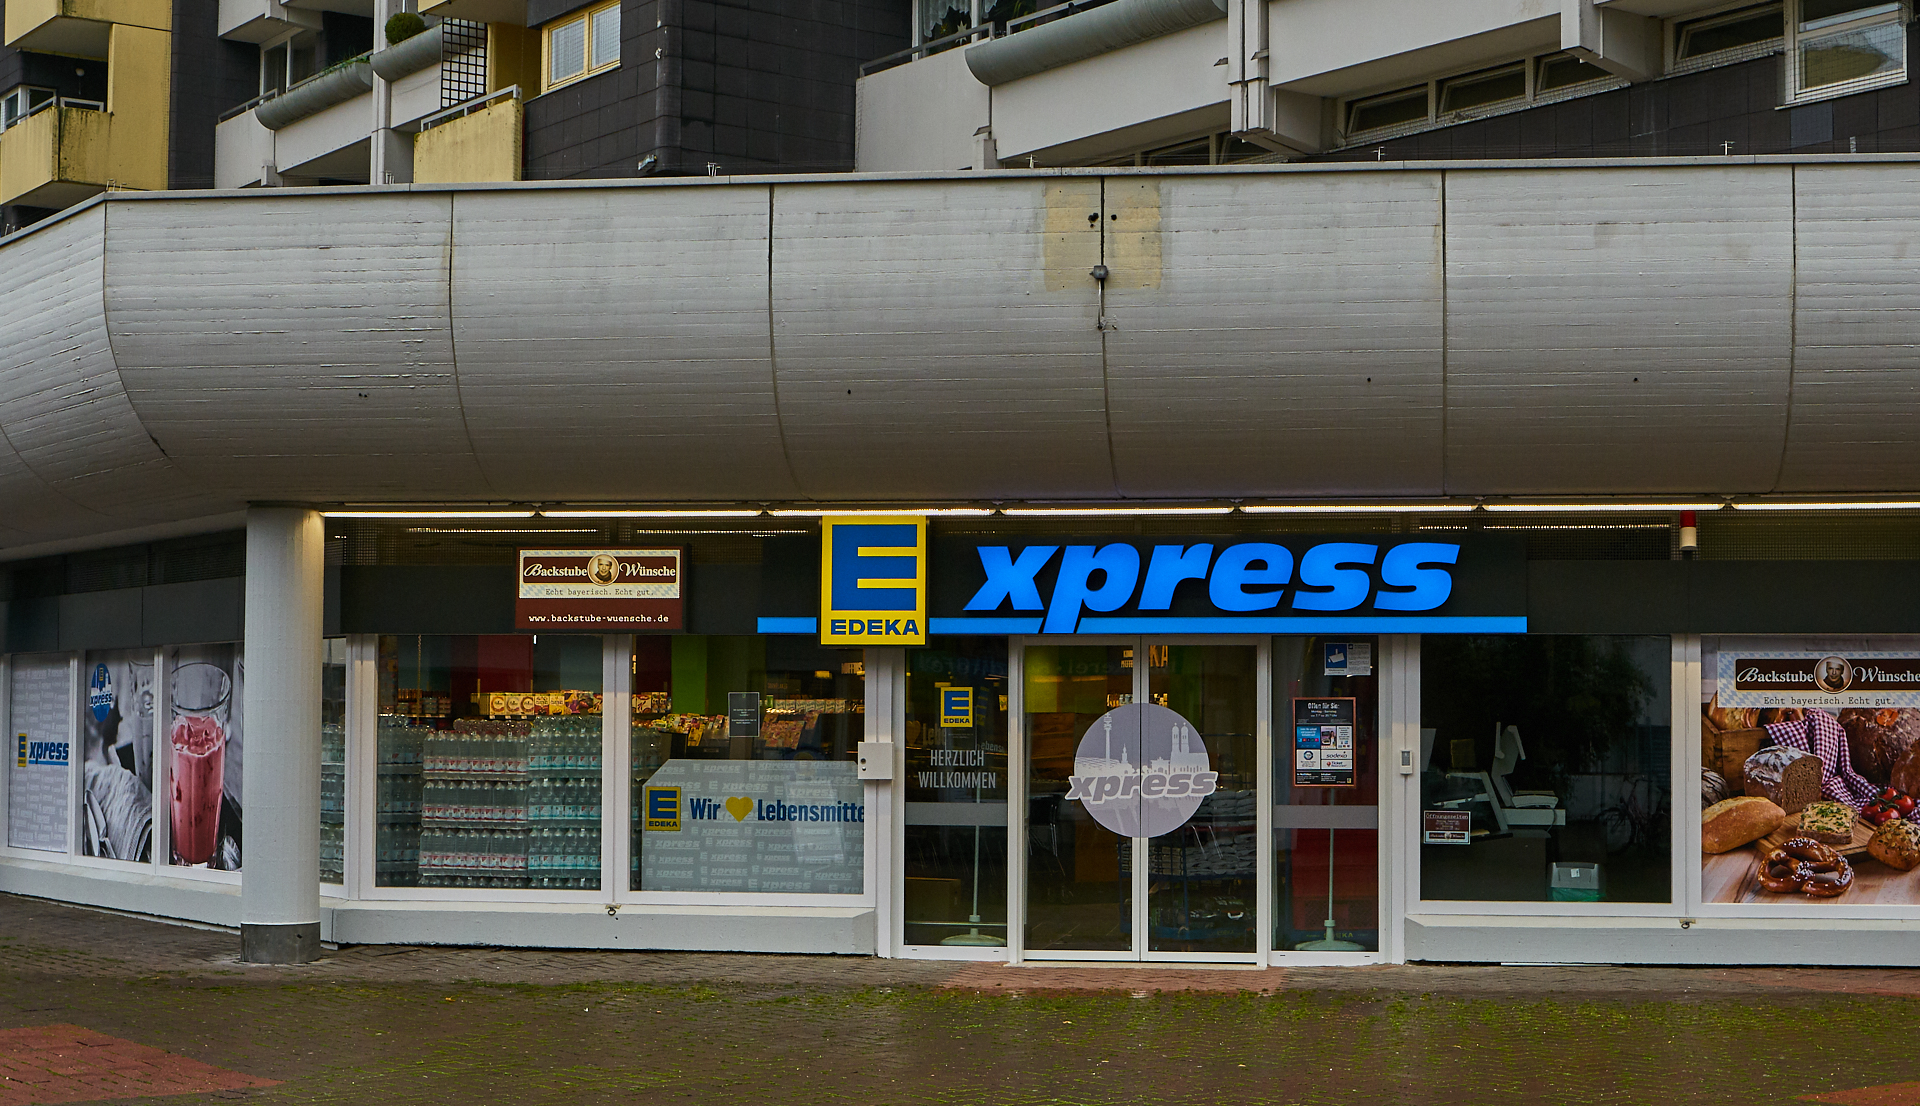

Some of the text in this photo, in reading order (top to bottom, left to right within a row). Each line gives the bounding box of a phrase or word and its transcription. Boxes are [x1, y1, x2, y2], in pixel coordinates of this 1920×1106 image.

[524, 562, 676, 577] Backstube Wünsche
[831, 524, 1460, 634] E xpress
[545, 588, 655, 597] Echt bayerisch. Echt gut.
[528, 614, 669, 623] www.backstube-wuensche.de
[831, 619, 919, 635] EDEKA
[1737, 665, 1920, 683] Backstube Wünsche
[1764, 697, 1896, 706] Echt bayerisch. Echt gut.
[29, 741, 69, 764] xpress
[930, 749, 984, 767] HERZLICH
[918, 771, 996, 789] WILLKOMMEN
[1066, 773, 1217, 802] xpress
[649, 790, 677, 819] E
[690, 798, 721, 820] Wir
[758, 799, 864, 822] Lebensmitte
